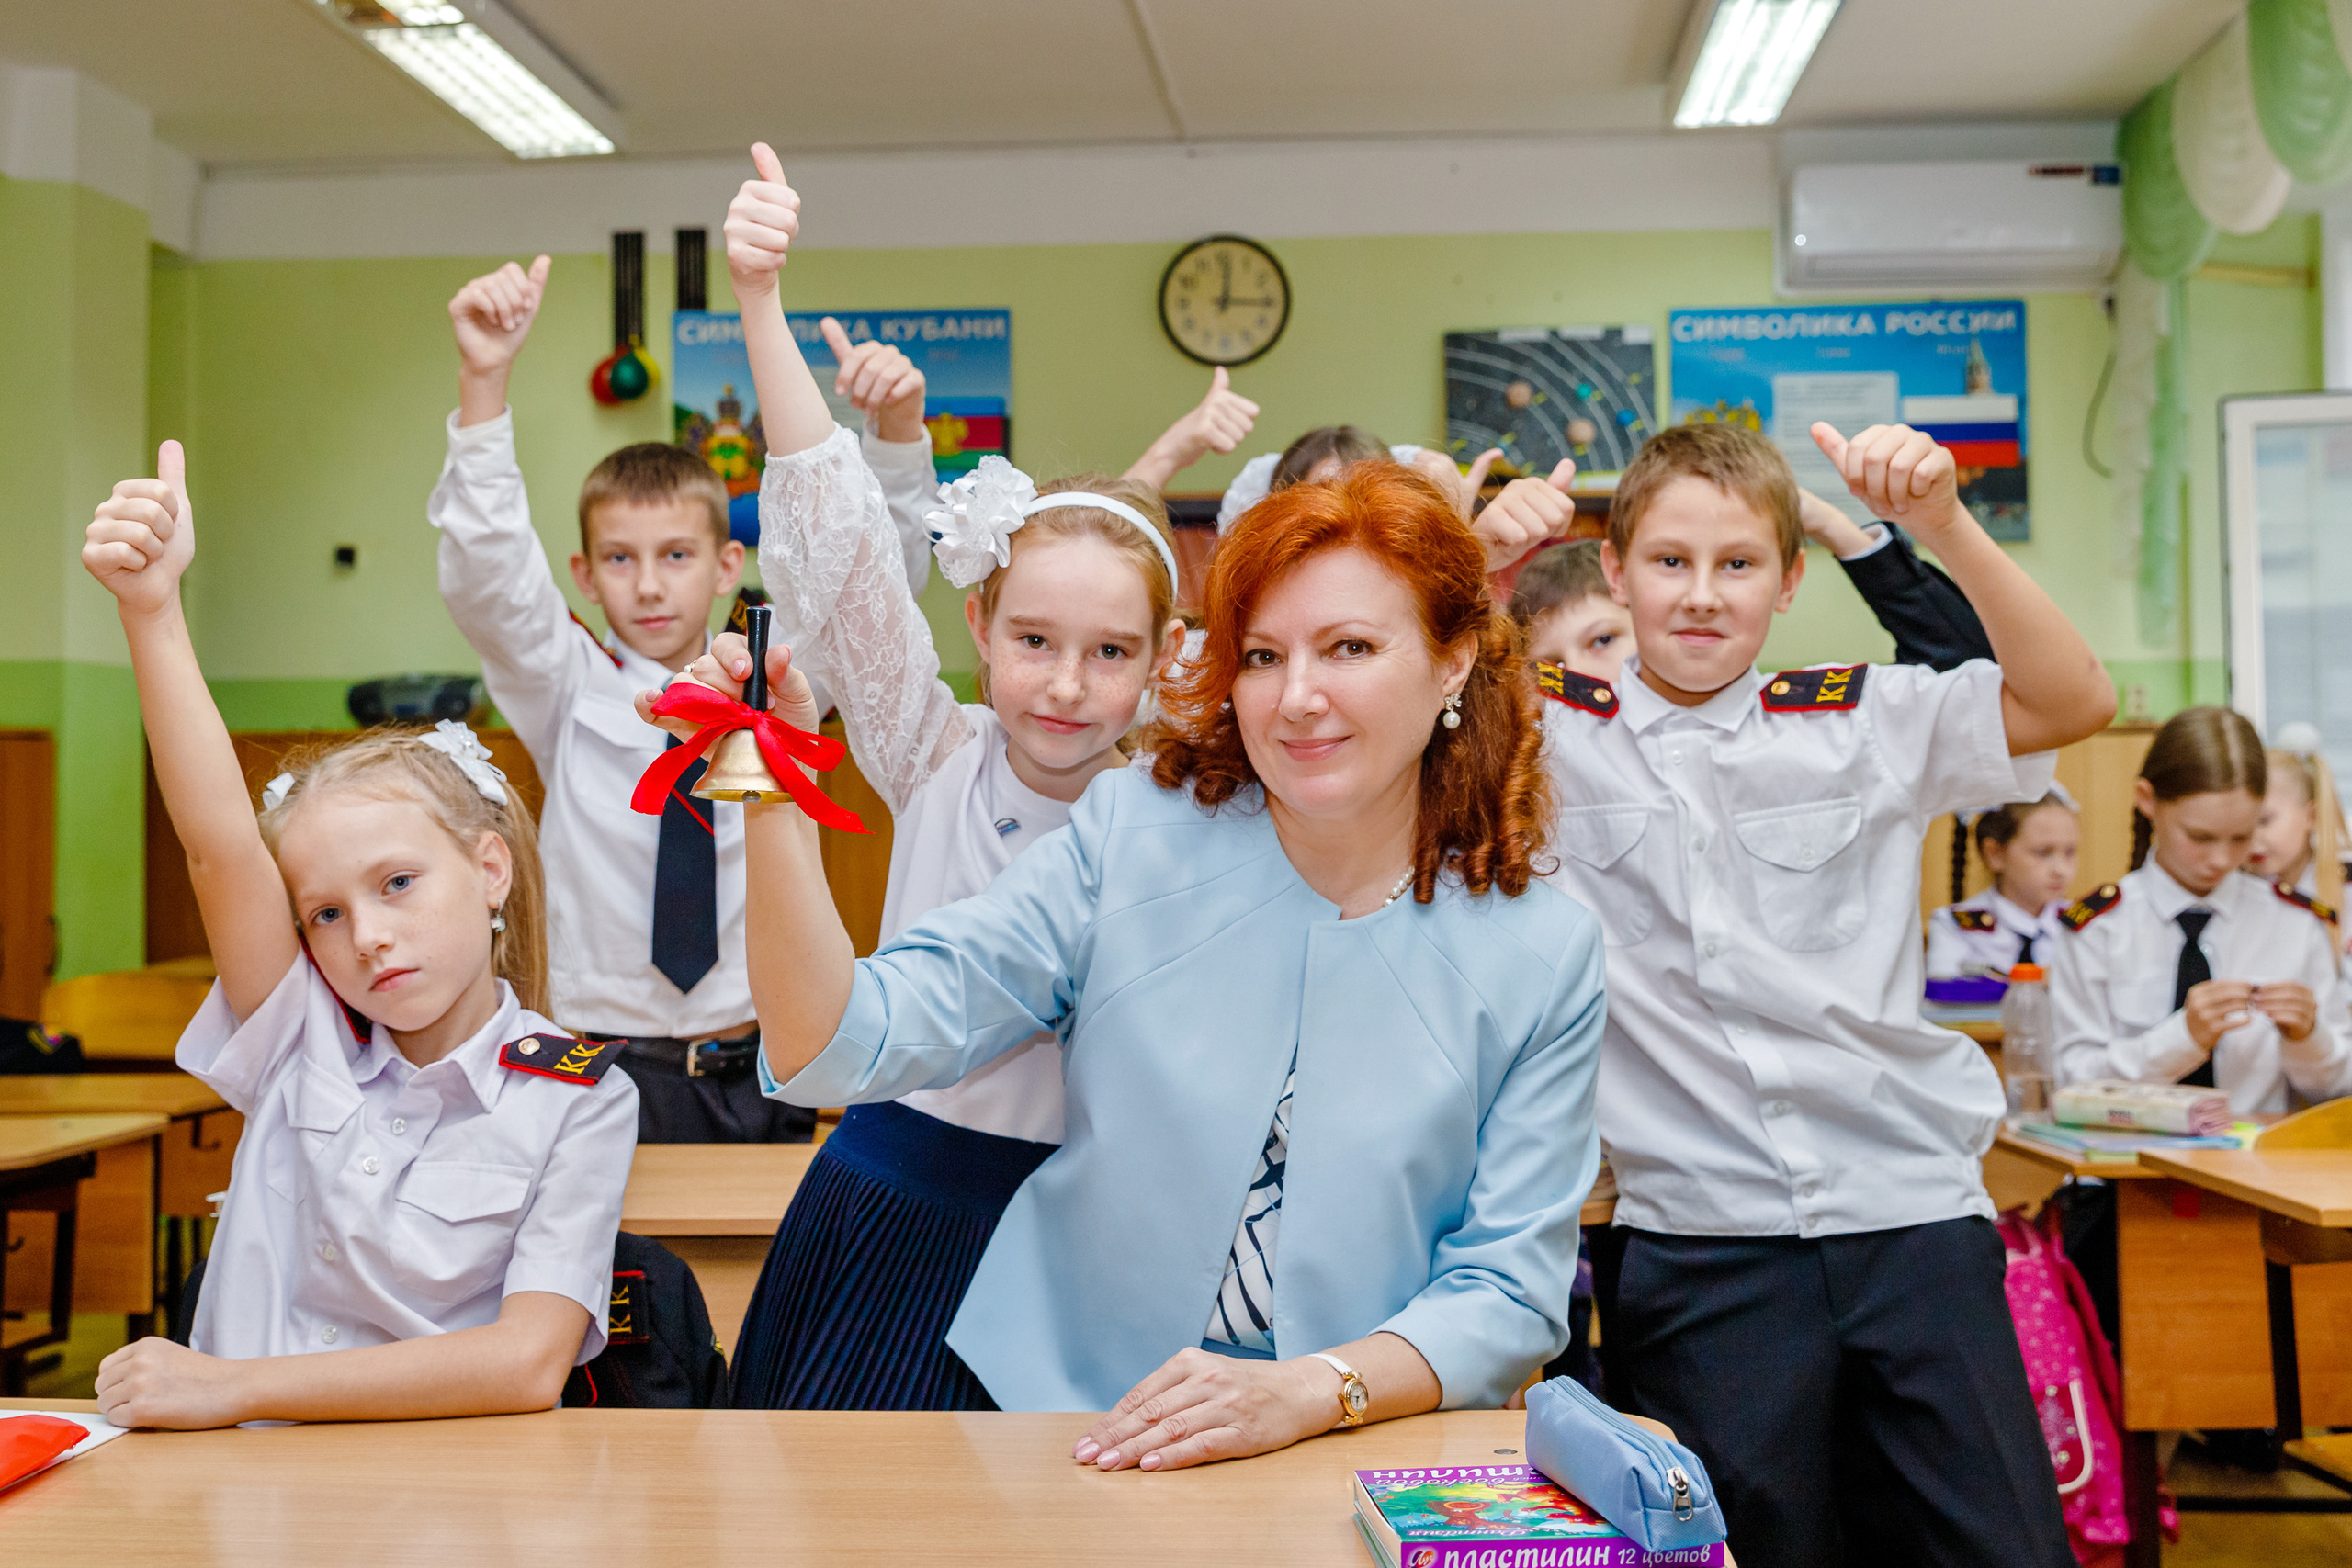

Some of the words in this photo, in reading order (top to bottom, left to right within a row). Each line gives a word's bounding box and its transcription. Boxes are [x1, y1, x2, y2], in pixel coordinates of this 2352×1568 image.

[880, 315, 1006, 342] КУБАНИ
[1672, 313, 1878, 344] СИМВОЛИКА
[1885, 310, 2017, 337] РОССИИ
[1443, 1545, 1610, 1568] пластилин
[1617, 1547, 1636, 1564] 12
[1643, 1543, 1711, 1567] цветов
